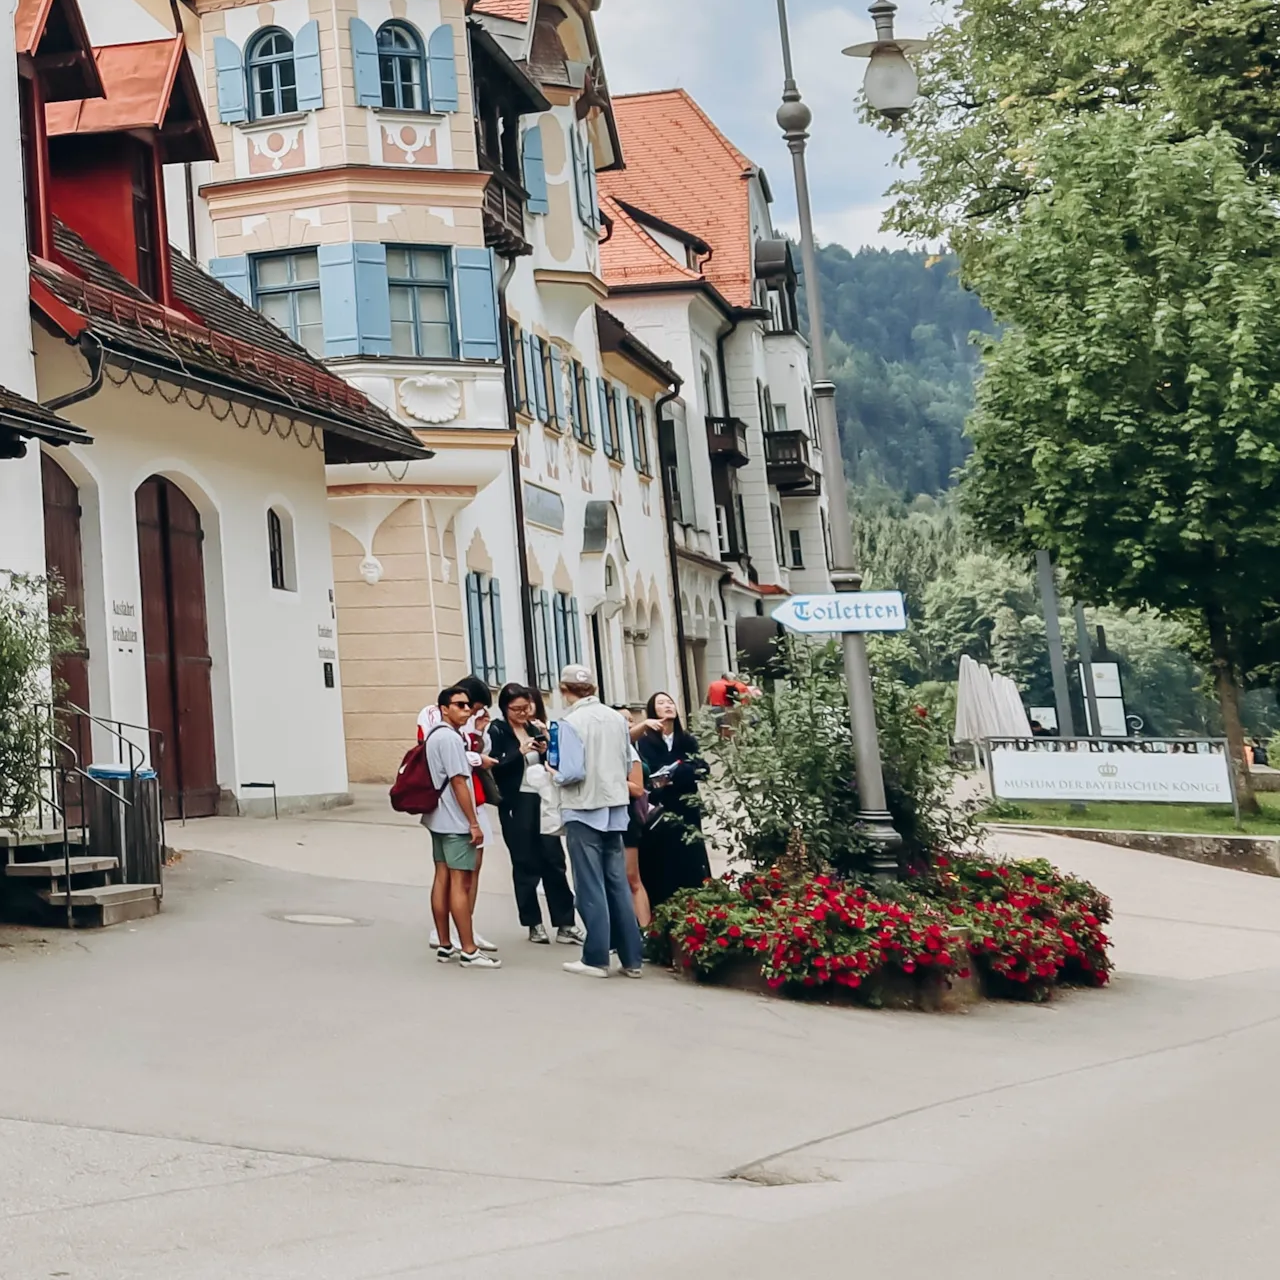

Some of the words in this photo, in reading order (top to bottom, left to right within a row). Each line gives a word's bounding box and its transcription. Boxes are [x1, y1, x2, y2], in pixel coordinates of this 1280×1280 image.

[792, 600, 898, 621] Toiletten
[1004, 779, 1057, 790] MUSEUM
[1059, 780, 1083, 790] DER
[1085, 780, 1169, 792] BAYERISCHEN
[1172, 781, 1222, 793] KÖNIGE
